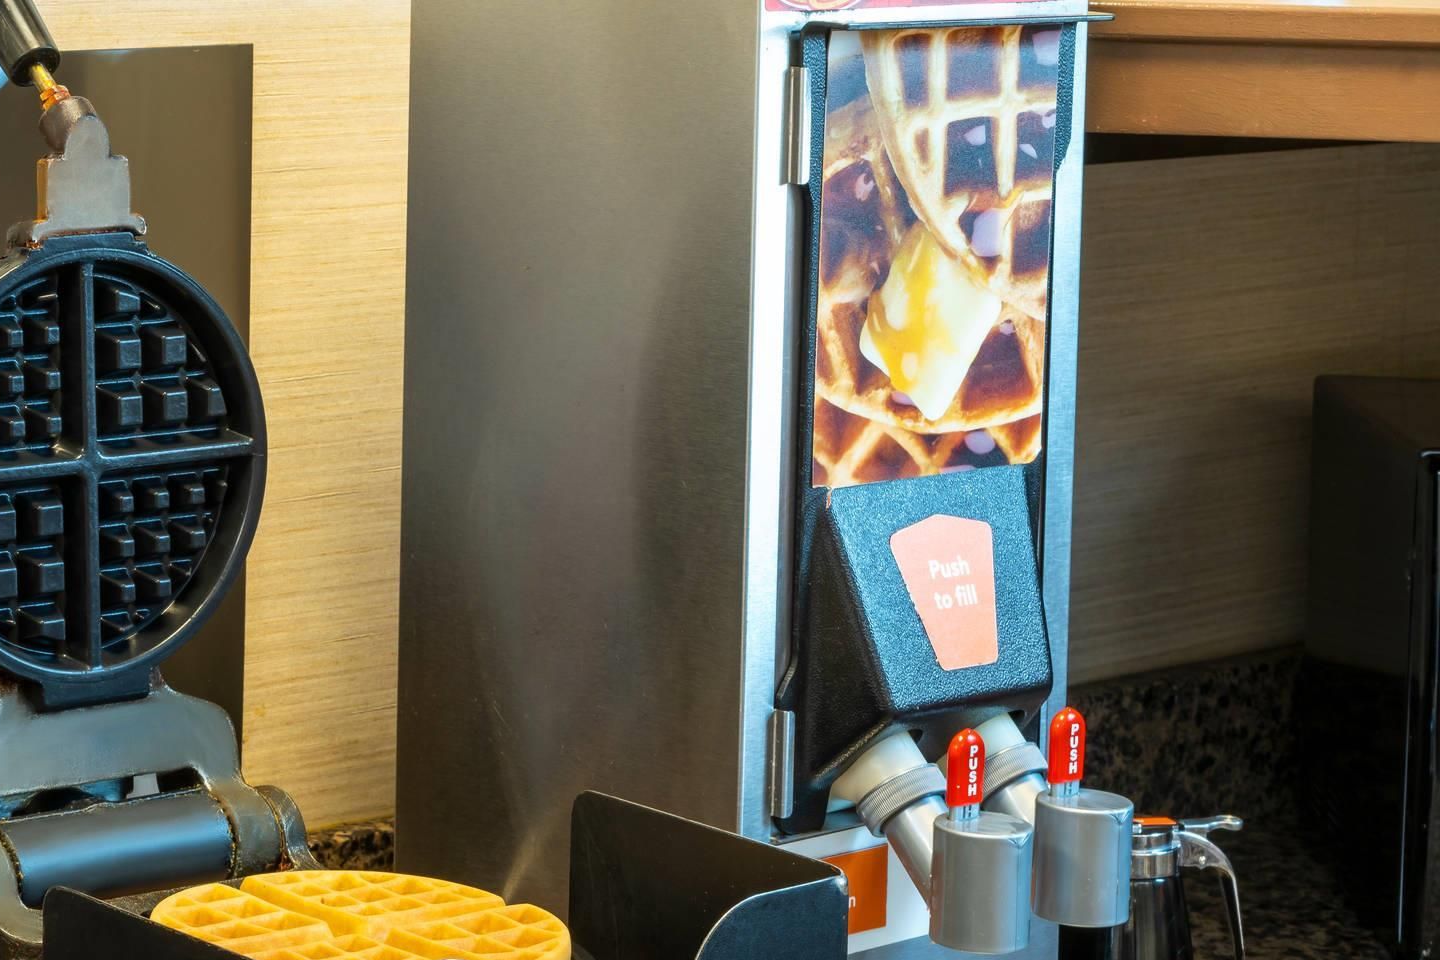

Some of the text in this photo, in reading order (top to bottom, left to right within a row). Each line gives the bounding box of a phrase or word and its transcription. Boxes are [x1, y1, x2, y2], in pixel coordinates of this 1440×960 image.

[928, 555, 970, 580] Push
[934, 584, 978, 610] to fill
[1069, 723, 1080, 774] PUSH
[967, 745, 978, 796] PUSH
